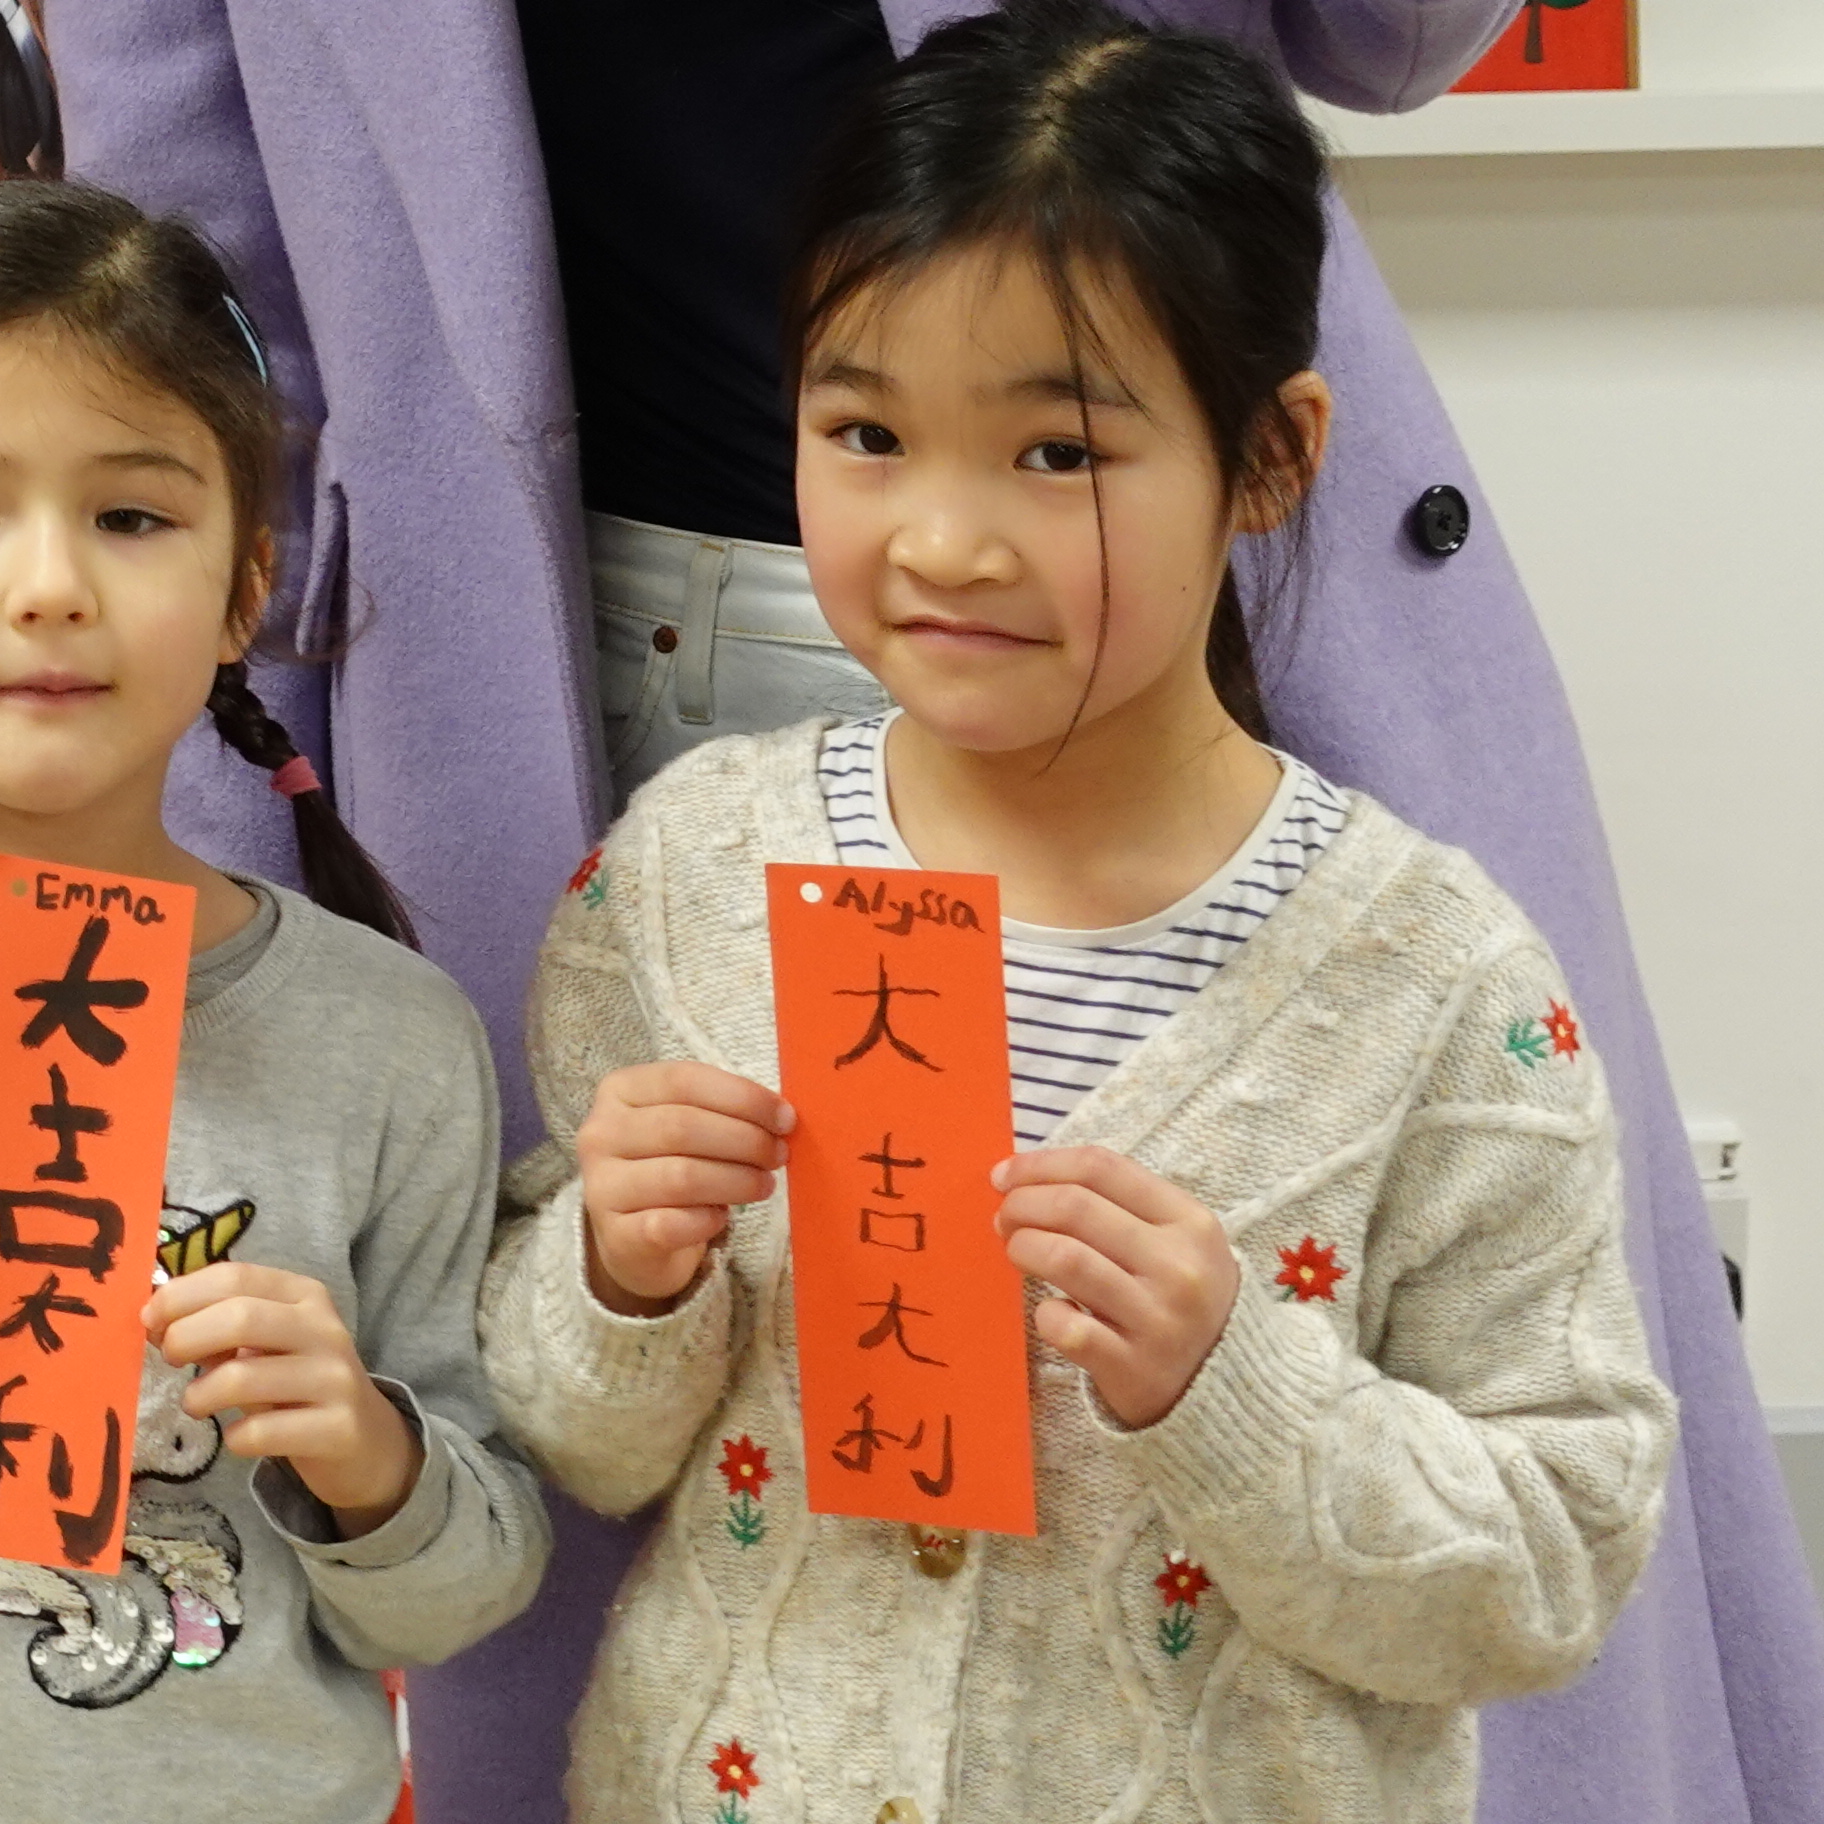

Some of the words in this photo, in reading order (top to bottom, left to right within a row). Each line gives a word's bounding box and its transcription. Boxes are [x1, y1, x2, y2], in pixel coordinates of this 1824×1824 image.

[37, 872, 166, 925] Emma
[833, 877, 985, 936] Alyssa
[829, 952, 955, 1498] 大吉大利
